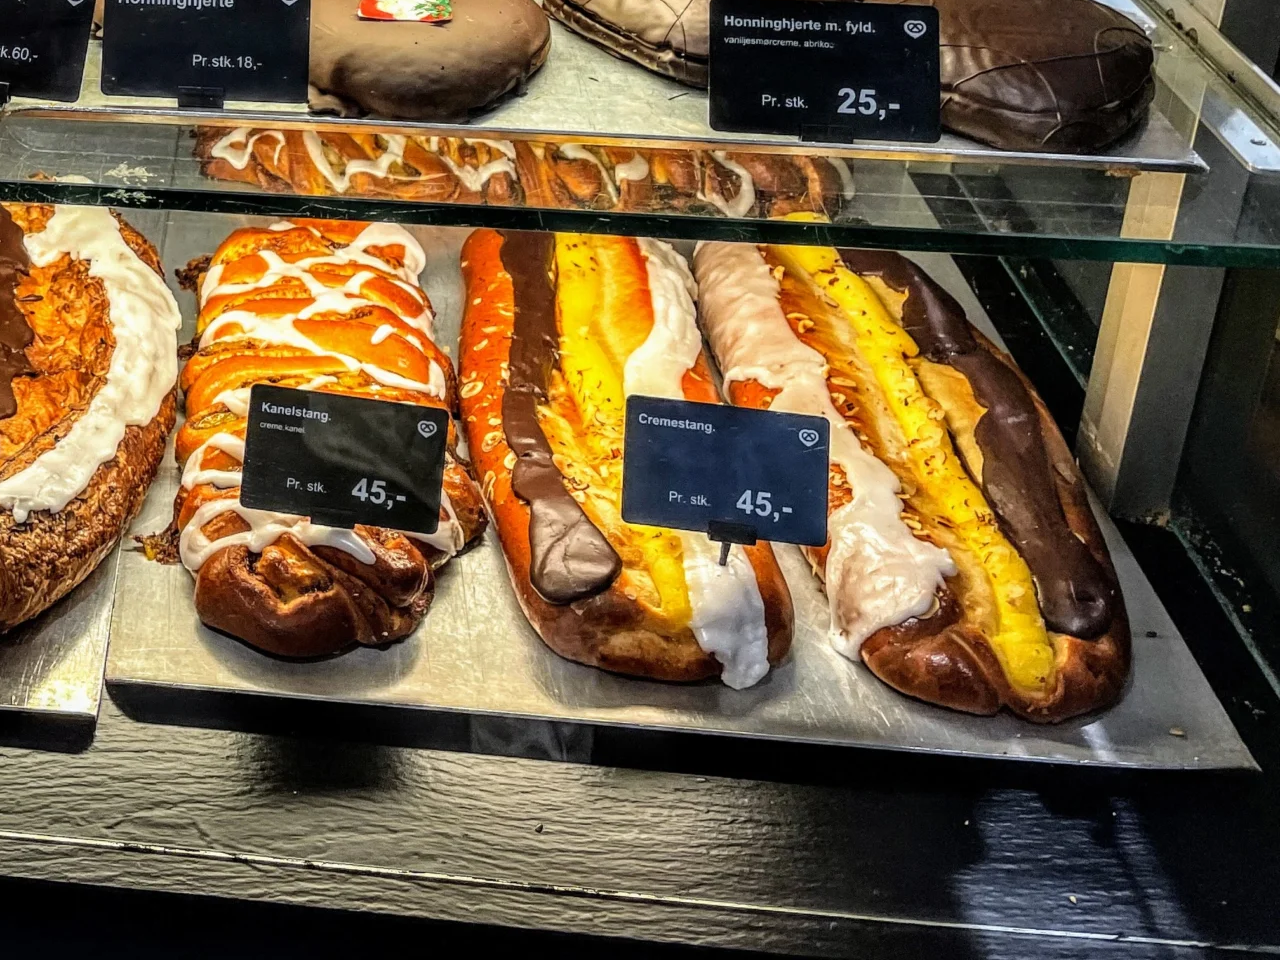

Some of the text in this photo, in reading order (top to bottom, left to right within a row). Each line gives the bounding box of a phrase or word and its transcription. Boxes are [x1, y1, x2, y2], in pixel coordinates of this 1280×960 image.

[724, 15, 876, 35] Honninghjerte m. fyld.
[192, 54, 263, 70] Pr.stk.18,-
[762, 87, 901, 121] Pr. stk. 25,-
[261, 402, 332, 423] Kanelstang.
[638, 413, 716, 434] Cremestang.
[286, 477, 407, 510] Pr. stk. 45,-
[669, 490, 793, 522] Pr. stk. 45,-
